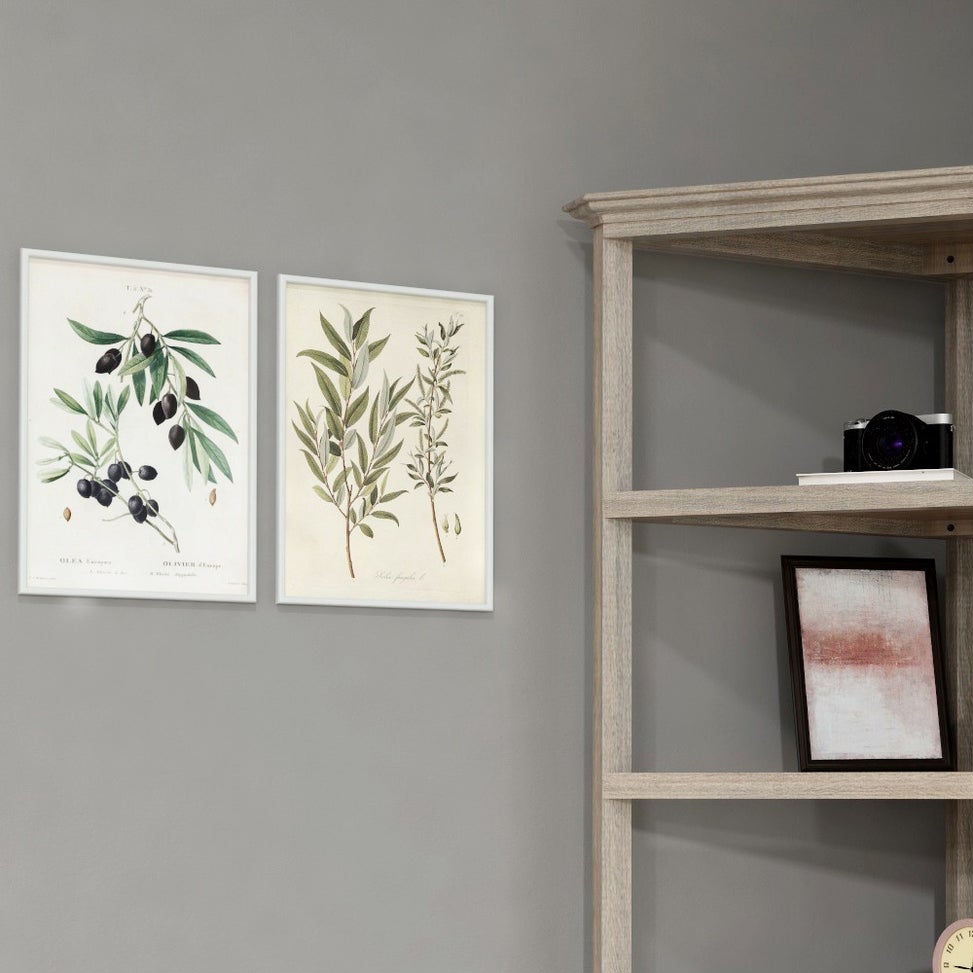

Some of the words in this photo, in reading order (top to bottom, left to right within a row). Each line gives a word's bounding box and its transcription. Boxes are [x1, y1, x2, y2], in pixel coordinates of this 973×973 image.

[162, 560, 196, 568] OLIVIER
[955, 933, 964, 942] 11
[946, 943, 955, 954] 10
